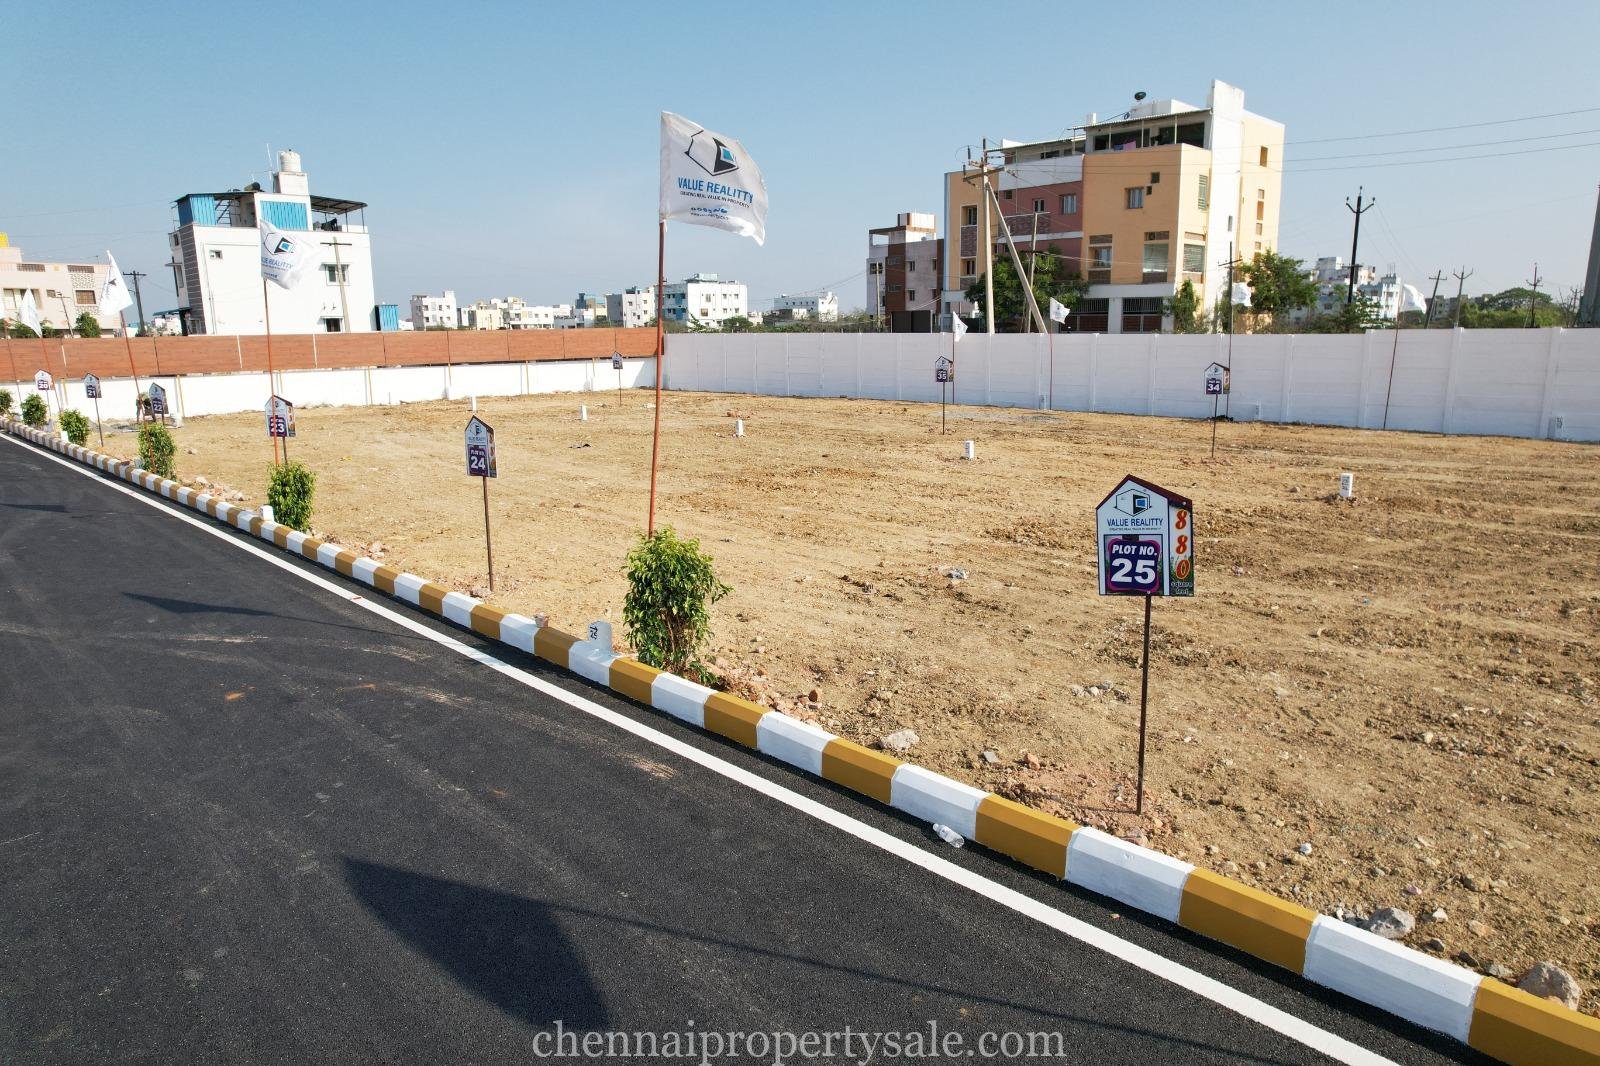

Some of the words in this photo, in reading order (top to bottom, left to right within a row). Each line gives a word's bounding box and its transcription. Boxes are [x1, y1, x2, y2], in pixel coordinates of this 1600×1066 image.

[678, 177, 704, 192] VALUE
[706, 181, 753, 204] REALITTY
[1207, 383, 1220, 391] 34
[470, 455, 486, 470] 24
[1106, 518, 1129, 527] VALUE
[1130, 518, 1164, 527] REALITTY
[1112, 544, 1137, 555] PLOT
[1139, 545, 1158, 556] NO.
[1110, 558, 1156, 585] 25
